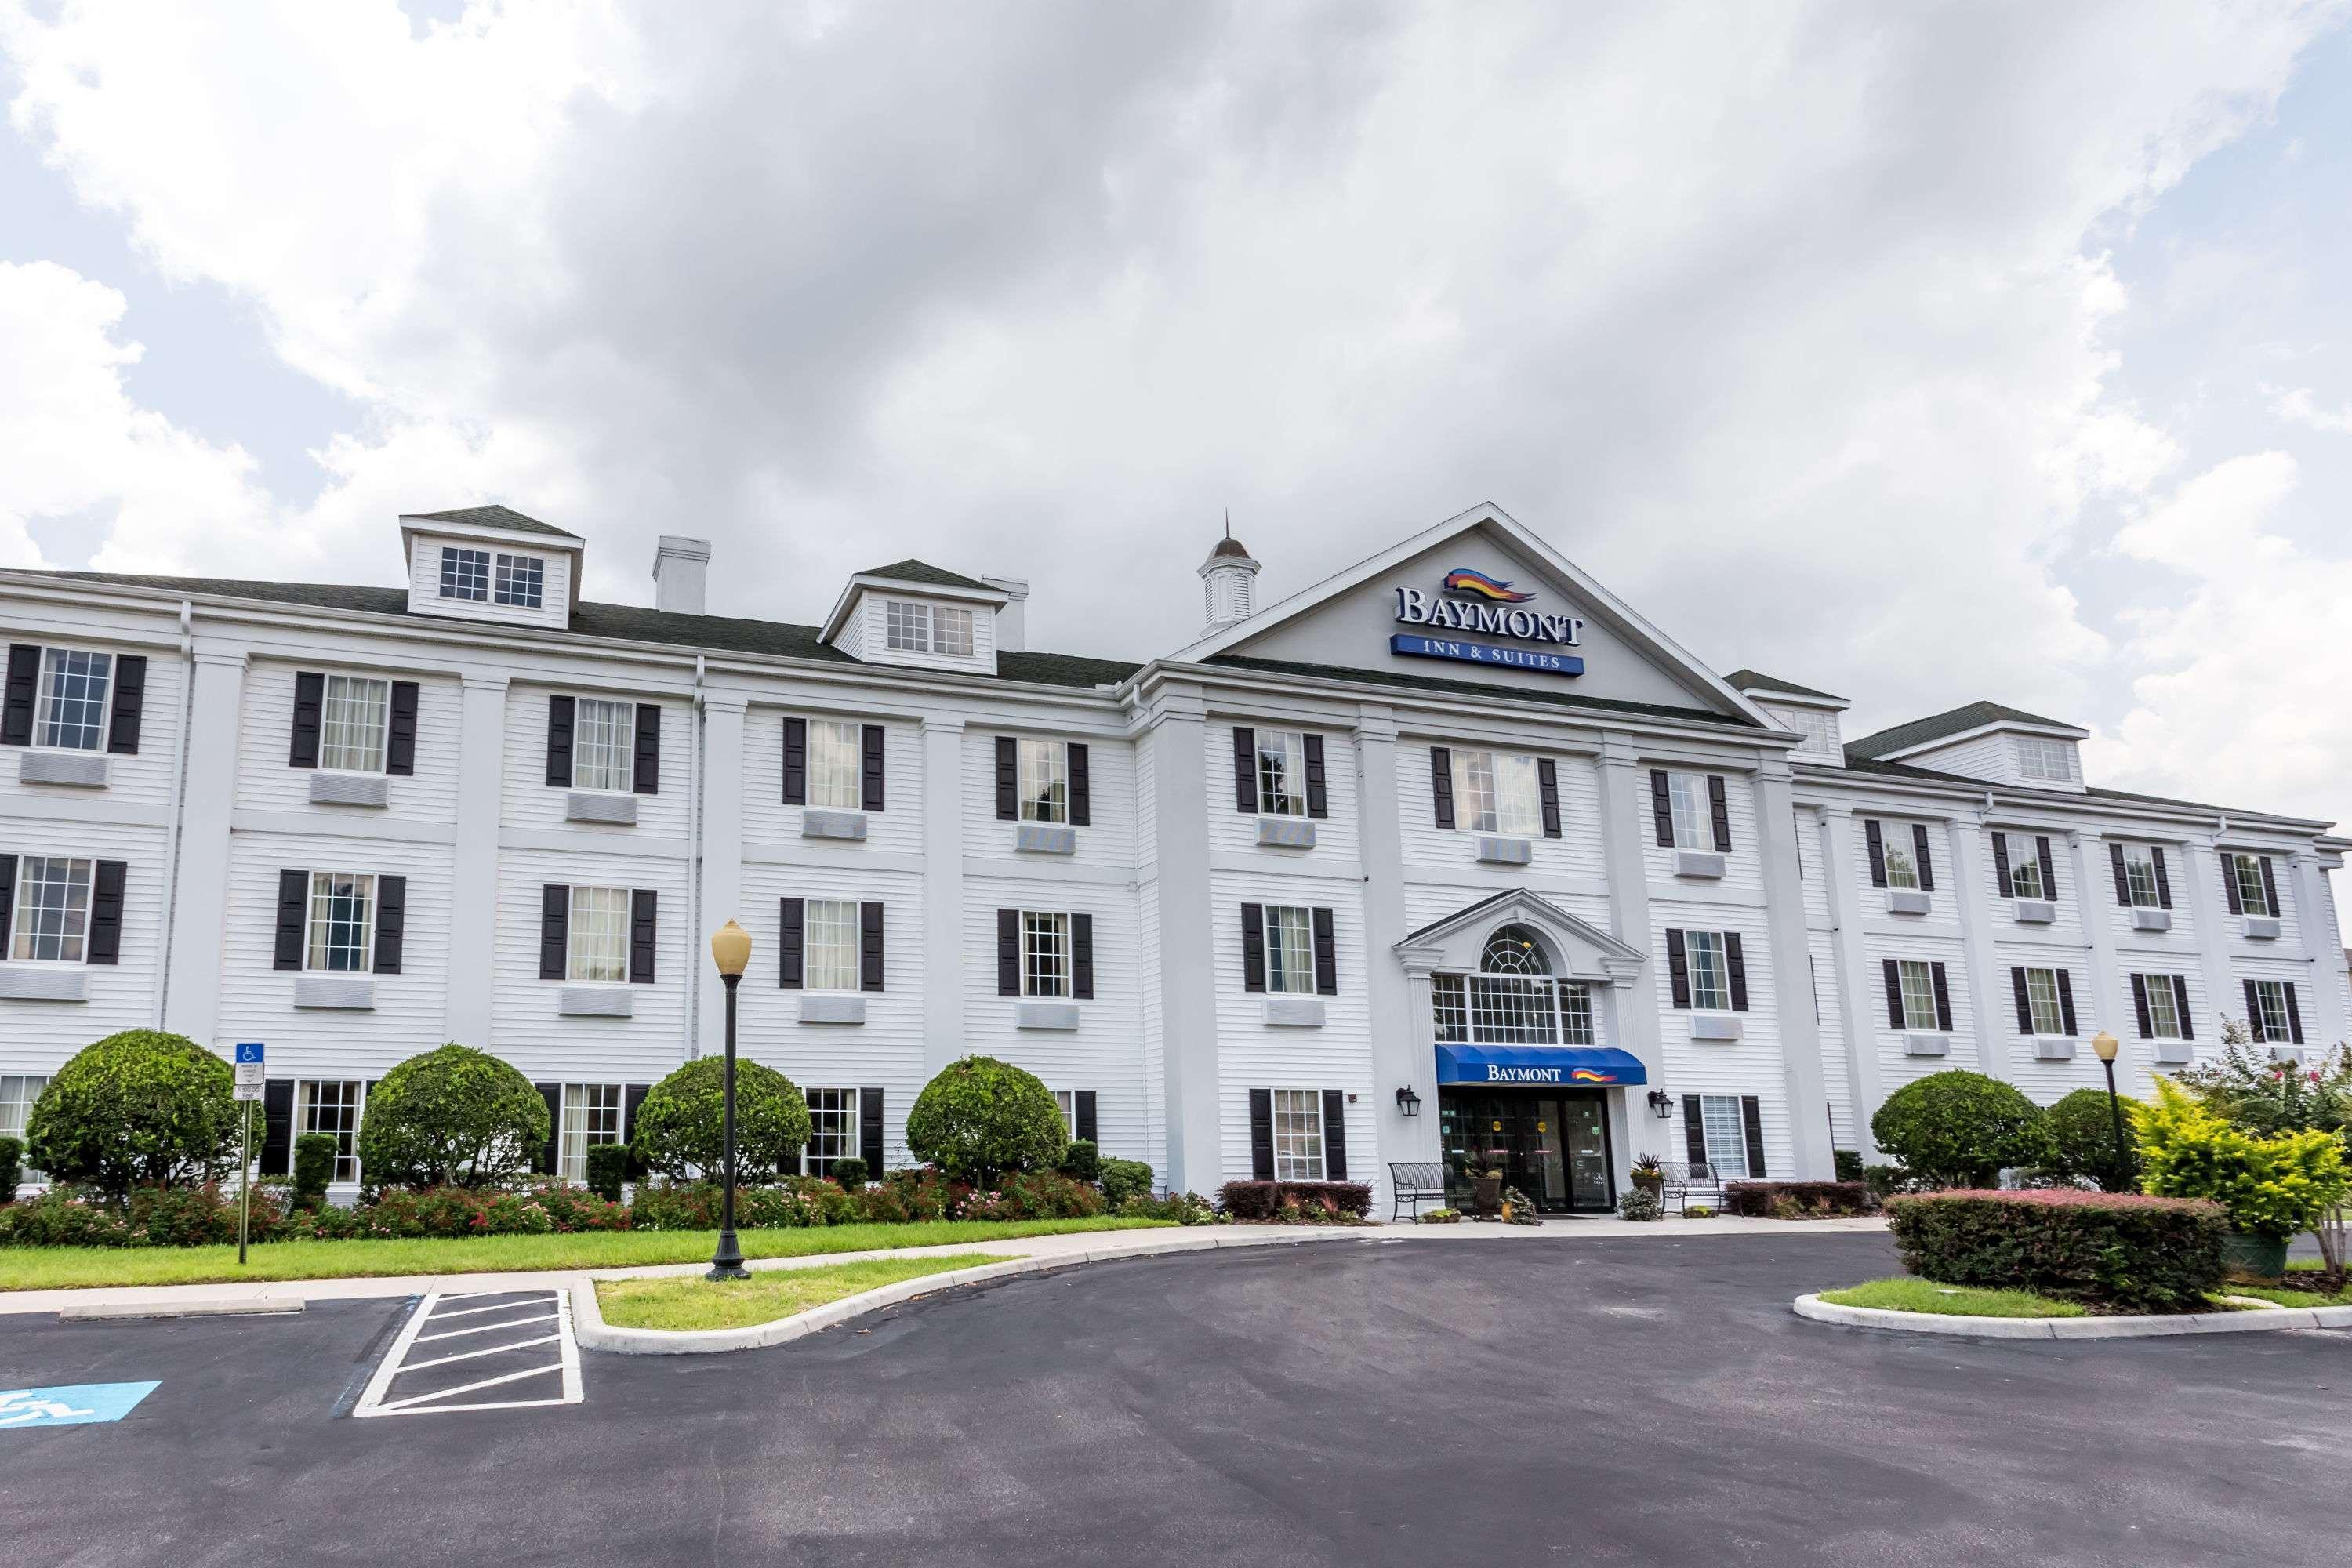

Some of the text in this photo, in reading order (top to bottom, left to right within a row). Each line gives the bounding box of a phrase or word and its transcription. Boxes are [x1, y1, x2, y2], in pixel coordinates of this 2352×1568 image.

[1396, 586, 1584, 646] BAYMONT
[1424, 640, 1560, 669] INN & SUITES
[1486, 1065, 1562, 1082] BAYMONT
